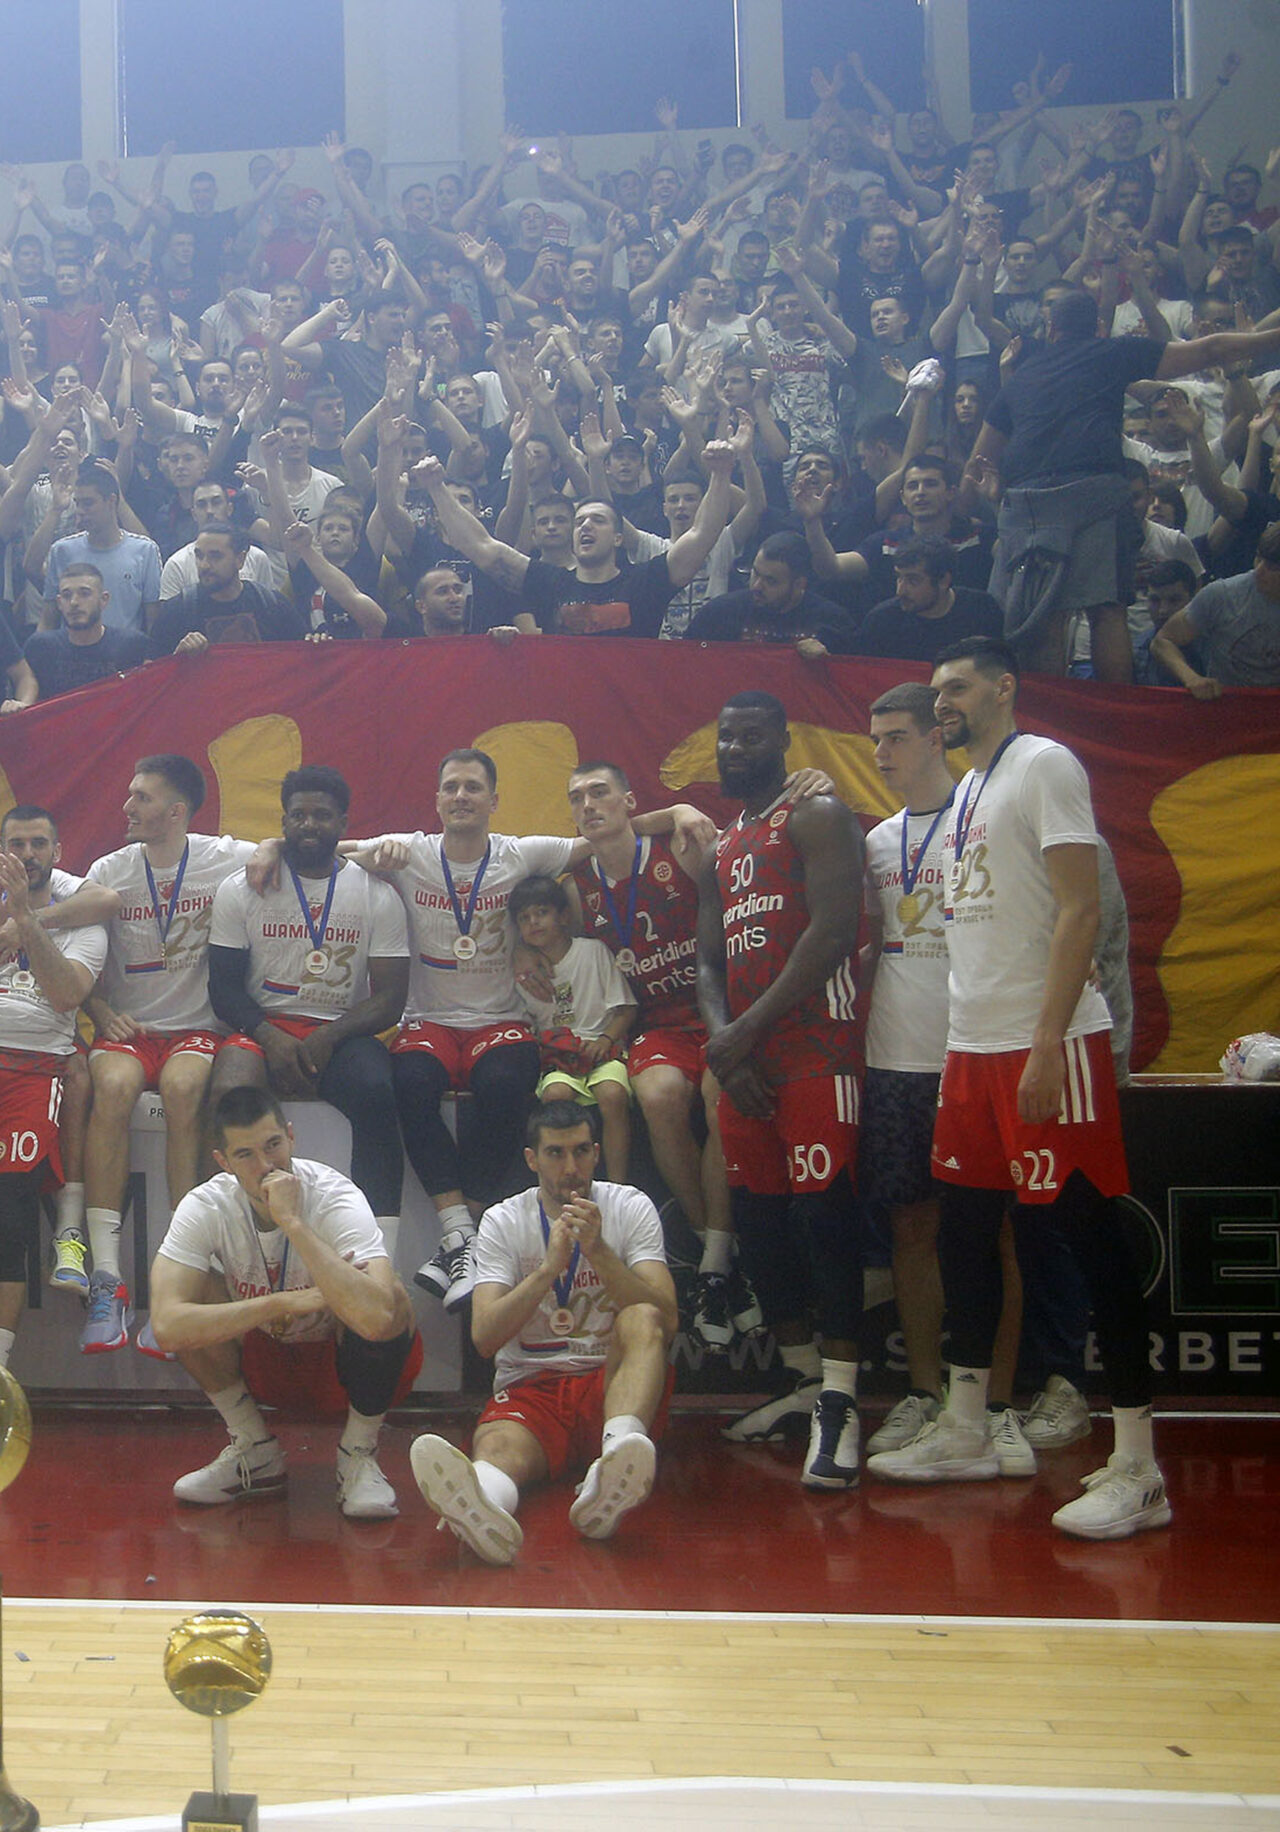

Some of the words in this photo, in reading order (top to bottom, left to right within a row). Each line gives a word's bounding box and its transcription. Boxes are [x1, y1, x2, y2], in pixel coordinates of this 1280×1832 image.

[729, 852, 755, 894] 50
[635, 910, 658, 942] 2
[726, 925, 768, 960] mts
[185, 1036, 217, 1050] 33
[489, 1028, 523, 1046] 20
[10, 1130, 39, 1162] 10
[793, 1143, 831, 1183] 50
[1023, 1148, 1058, 1191] 22
